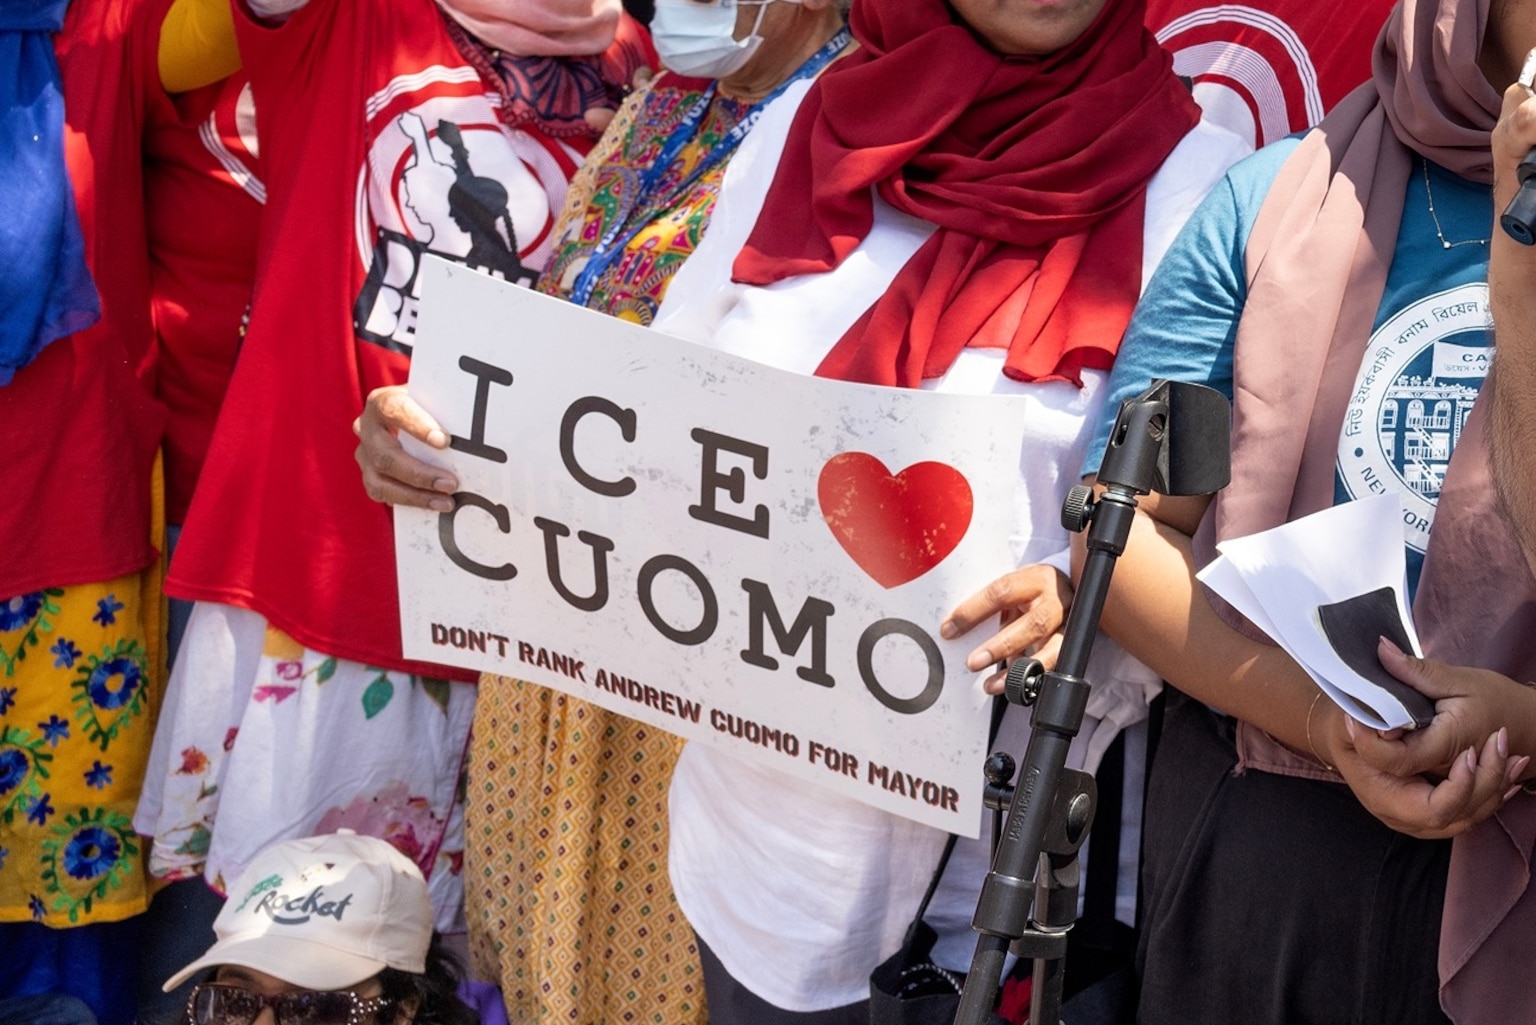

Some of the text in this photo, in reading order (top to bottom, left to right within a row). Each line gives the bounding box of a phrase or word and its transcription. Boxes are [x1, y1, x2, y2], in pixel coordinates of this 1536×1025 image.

[729, 104, 769, 142] UZE
[451, 355, 771, 540] ICE
[1403, 508, 1431, 535] OR
[438, 491, 945, 715] CUOMO
[431, 622, 959, 813] DON'T RANK ANDREW CUOMO FOR MAYOR
[254, 885, 353, 926] Rocket
